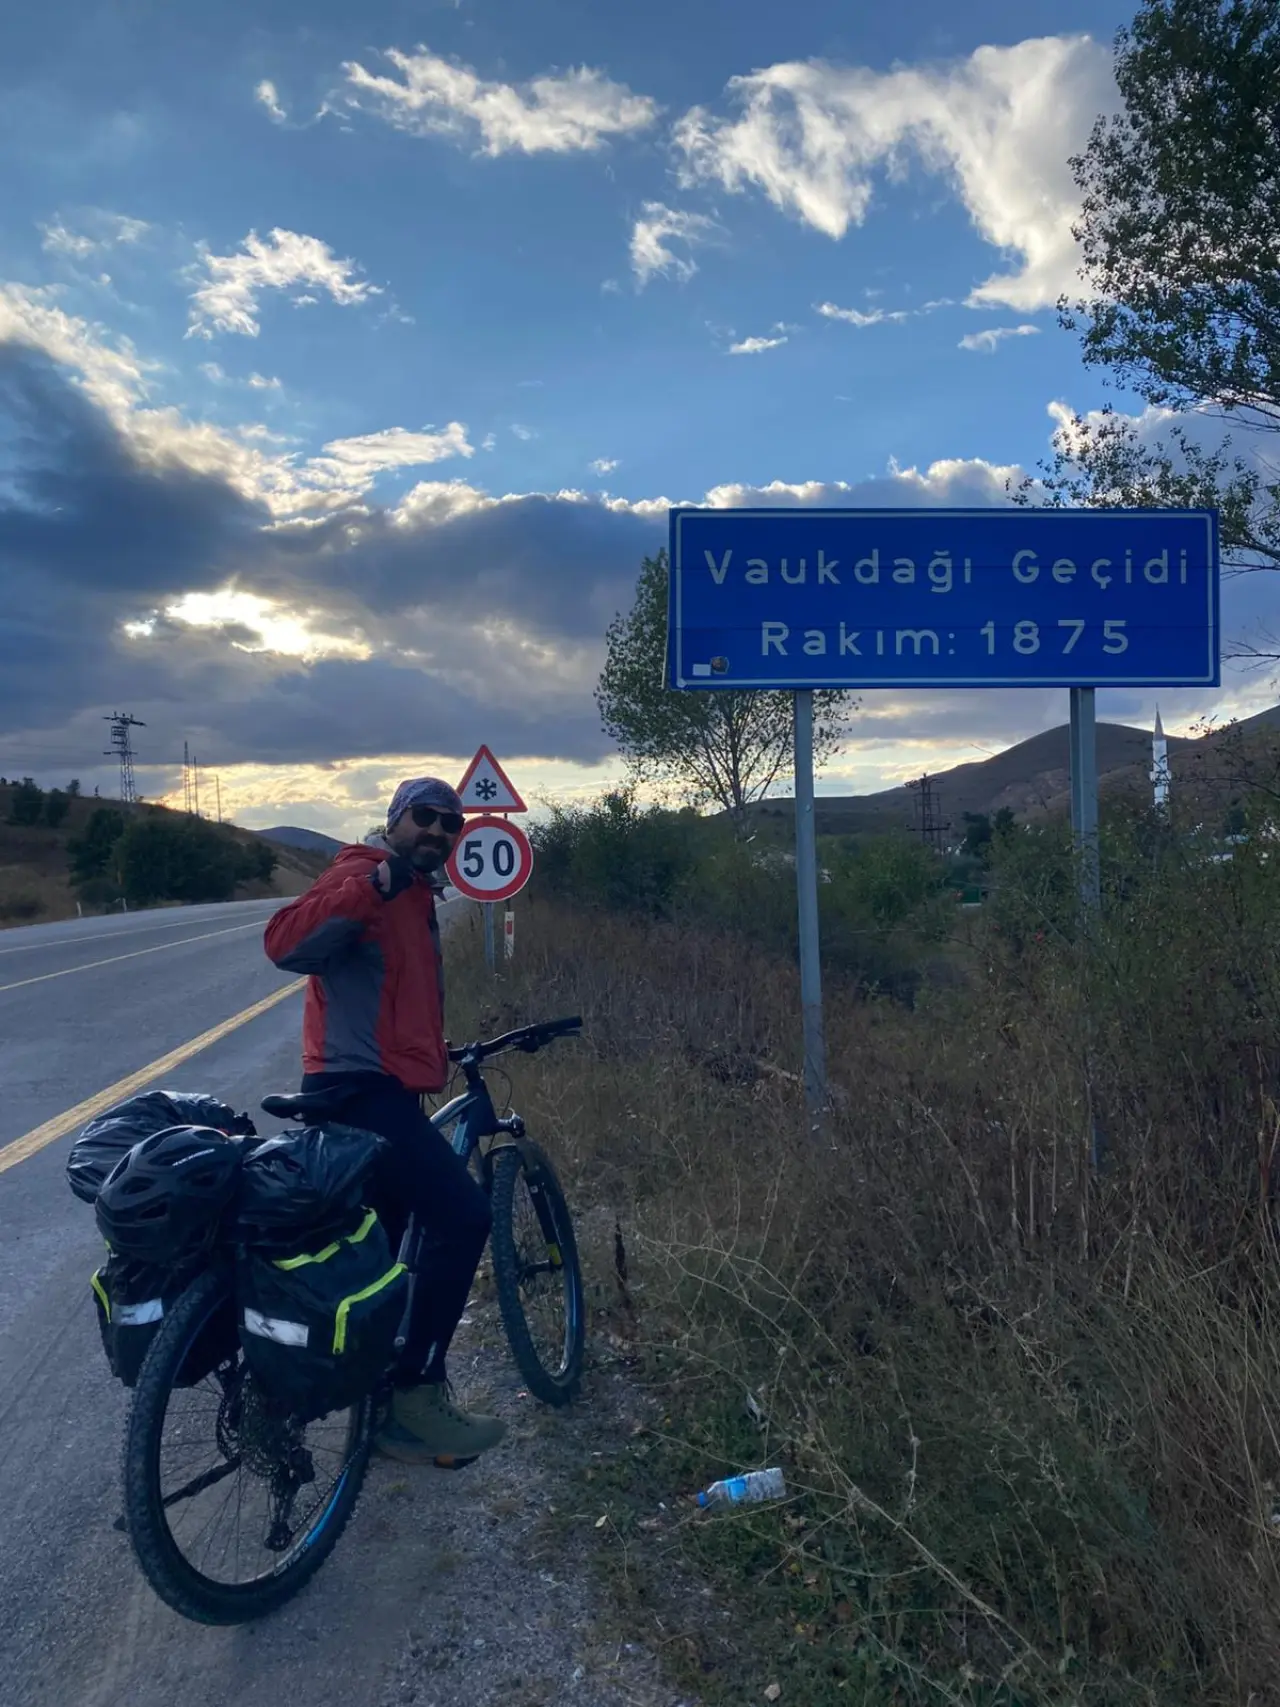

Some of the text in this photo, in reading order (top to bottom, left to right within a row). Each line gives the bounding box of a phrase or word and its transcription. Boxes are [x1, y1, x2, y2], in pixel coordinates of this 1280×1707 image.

[704, 549, 1188, 592] Vaukdağı Geçidi
[761, 619, 1130, 656] Rakım: 1875
[463, 839, 515, 878] 50
